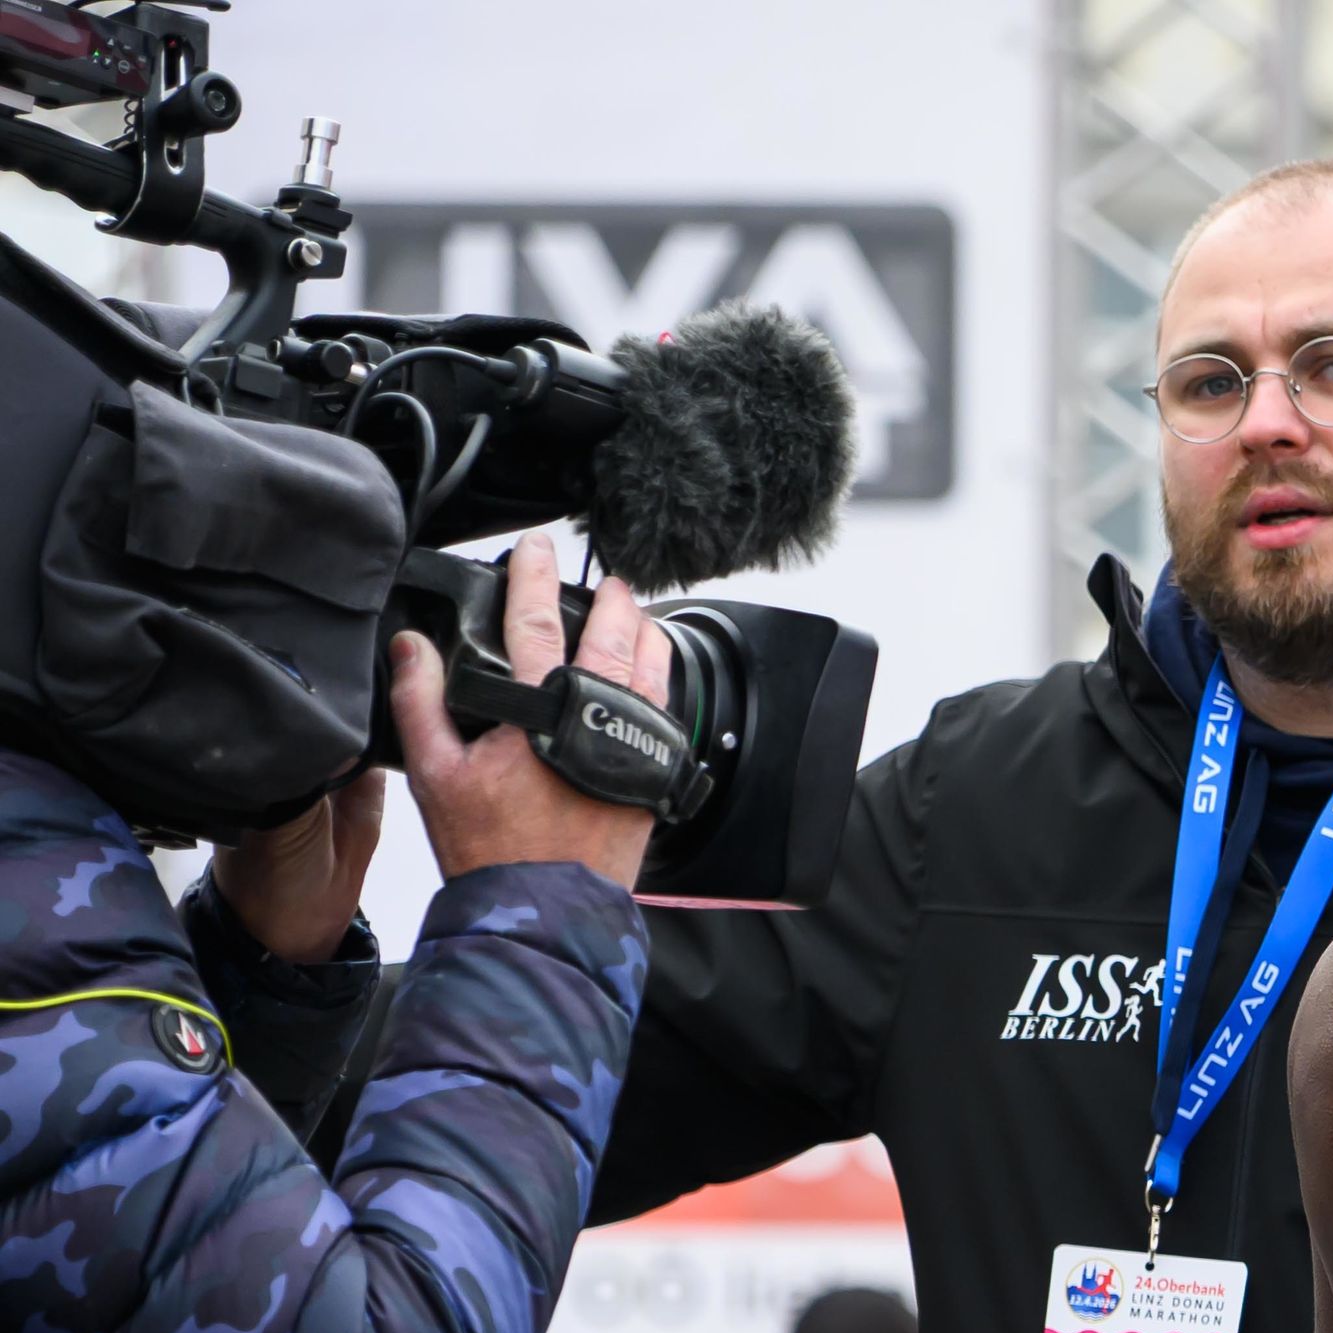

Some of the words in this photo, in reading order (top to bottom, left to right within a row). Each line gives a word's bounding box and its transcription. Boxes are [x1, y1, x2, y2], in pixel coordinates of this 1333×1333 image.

[582, 702, 671, 767] Canon
[1193, 753, 1222, 814] AG
[1008, 953, 1139, 1020] ISS
[1000, 1016, 1116, 1042] BERLIN
[1176, 1026, 1244, 1120] LINZ
[1239, 960, 1280, 1026] AG
[1131, 1293, 1165, 1307] LINZ
[1171, 1296, 1225, 1312] DONAU
[1134, 1275, 1226, 1297] 24.Oberbank
[1129, 1308, 1223, 1326] MARATHON
